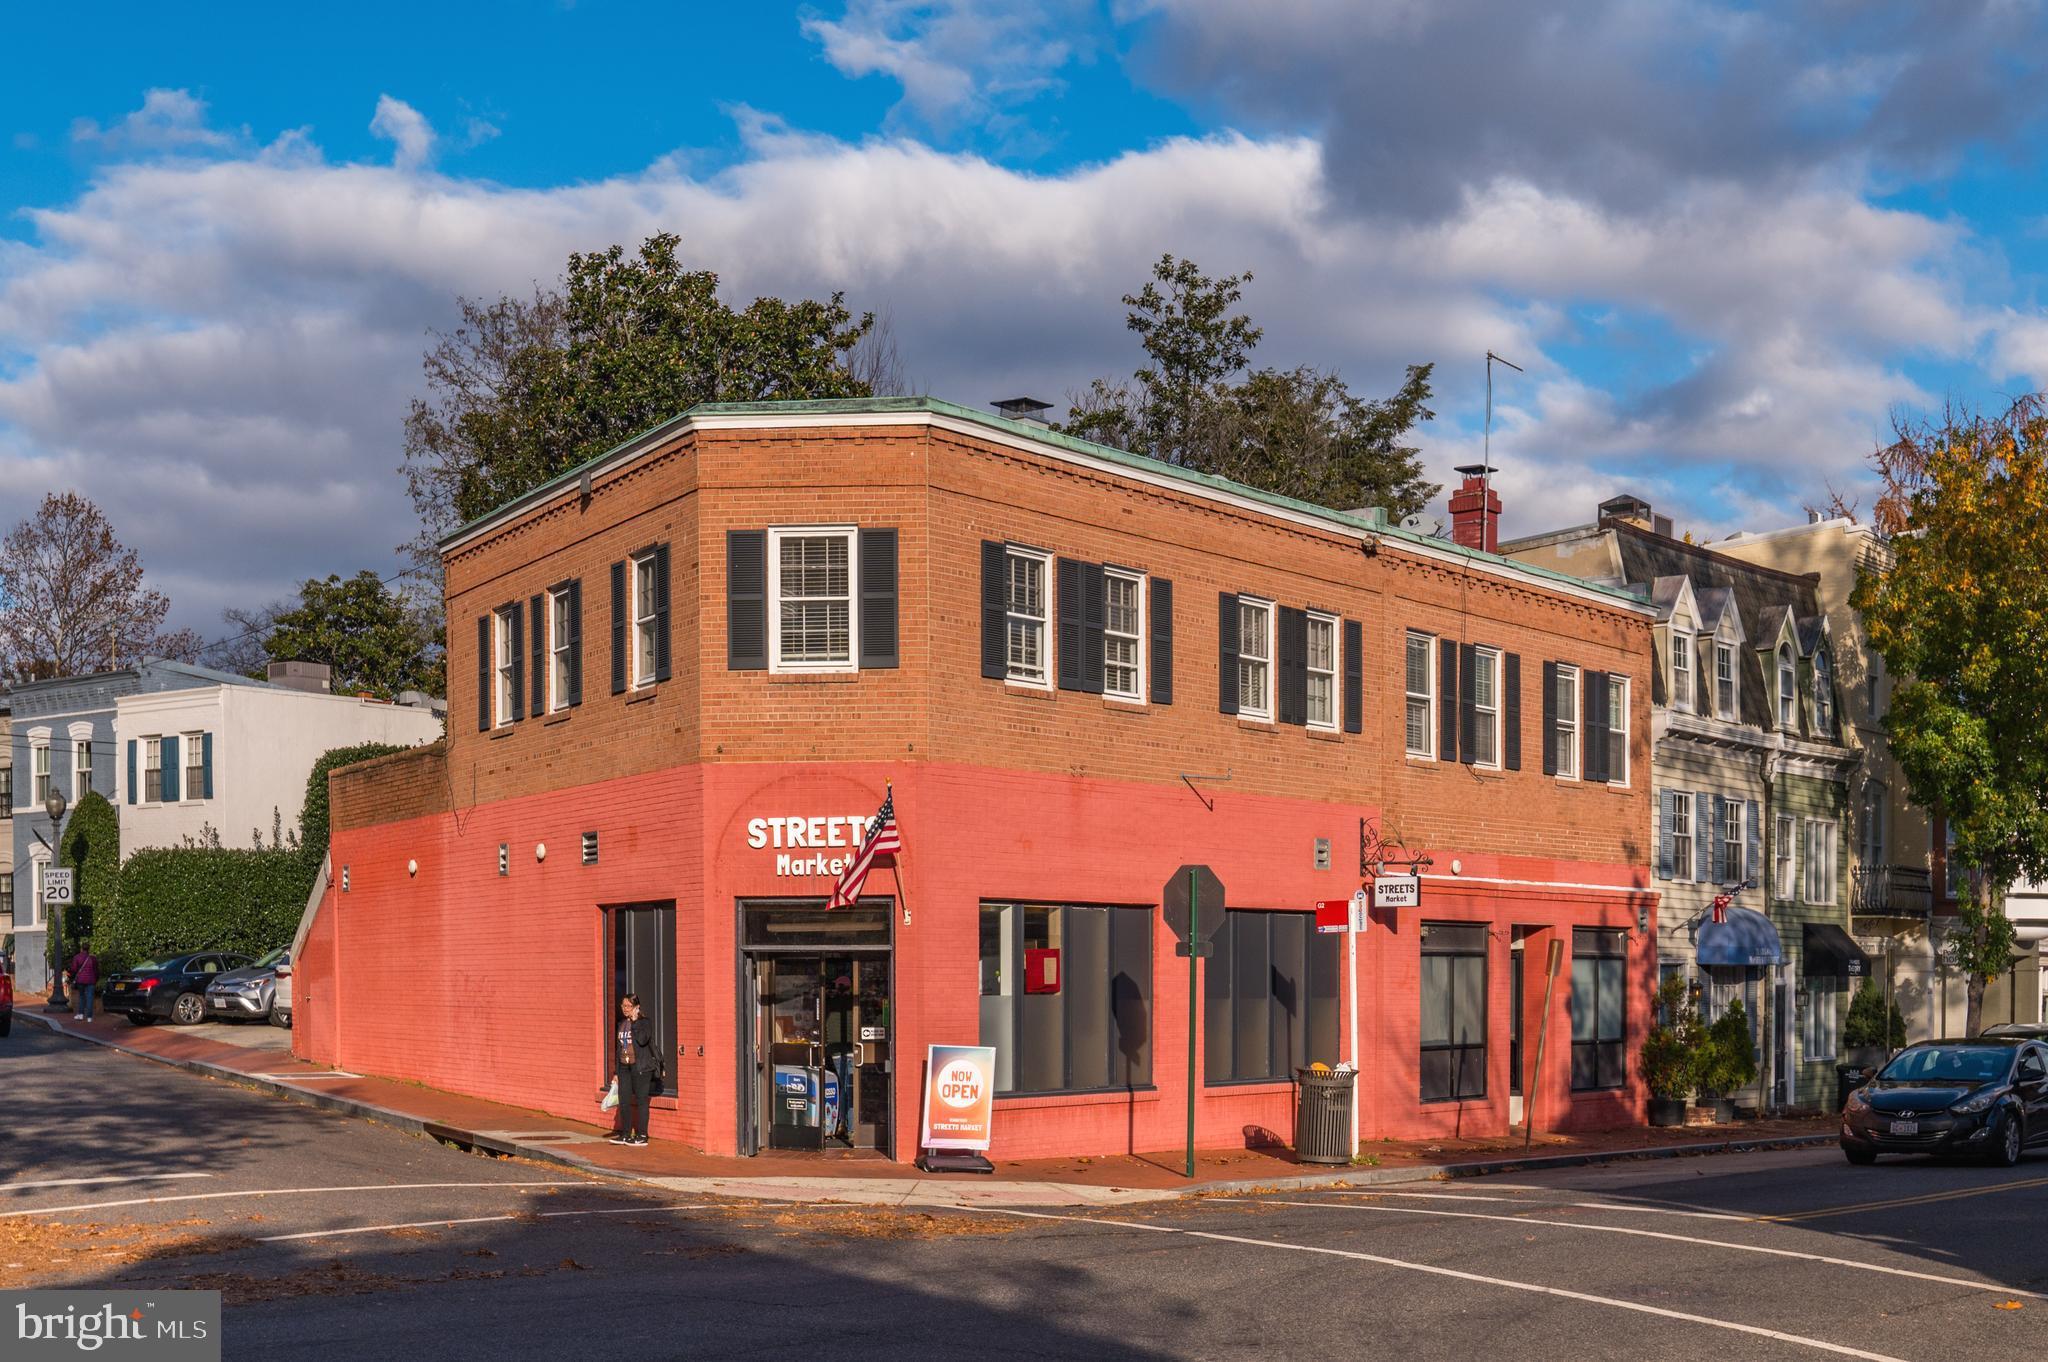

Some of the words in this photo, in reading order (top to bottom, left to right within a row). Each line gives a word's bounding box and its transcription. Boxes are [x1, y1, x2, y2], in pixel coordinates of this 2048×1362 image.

[46, 886, 69, 899] 20
[1378, 884, 1415, 894] STREETS
[951, 1071, 972, 1082] NOW
[942, 1084, 978, 1098] OPEN
